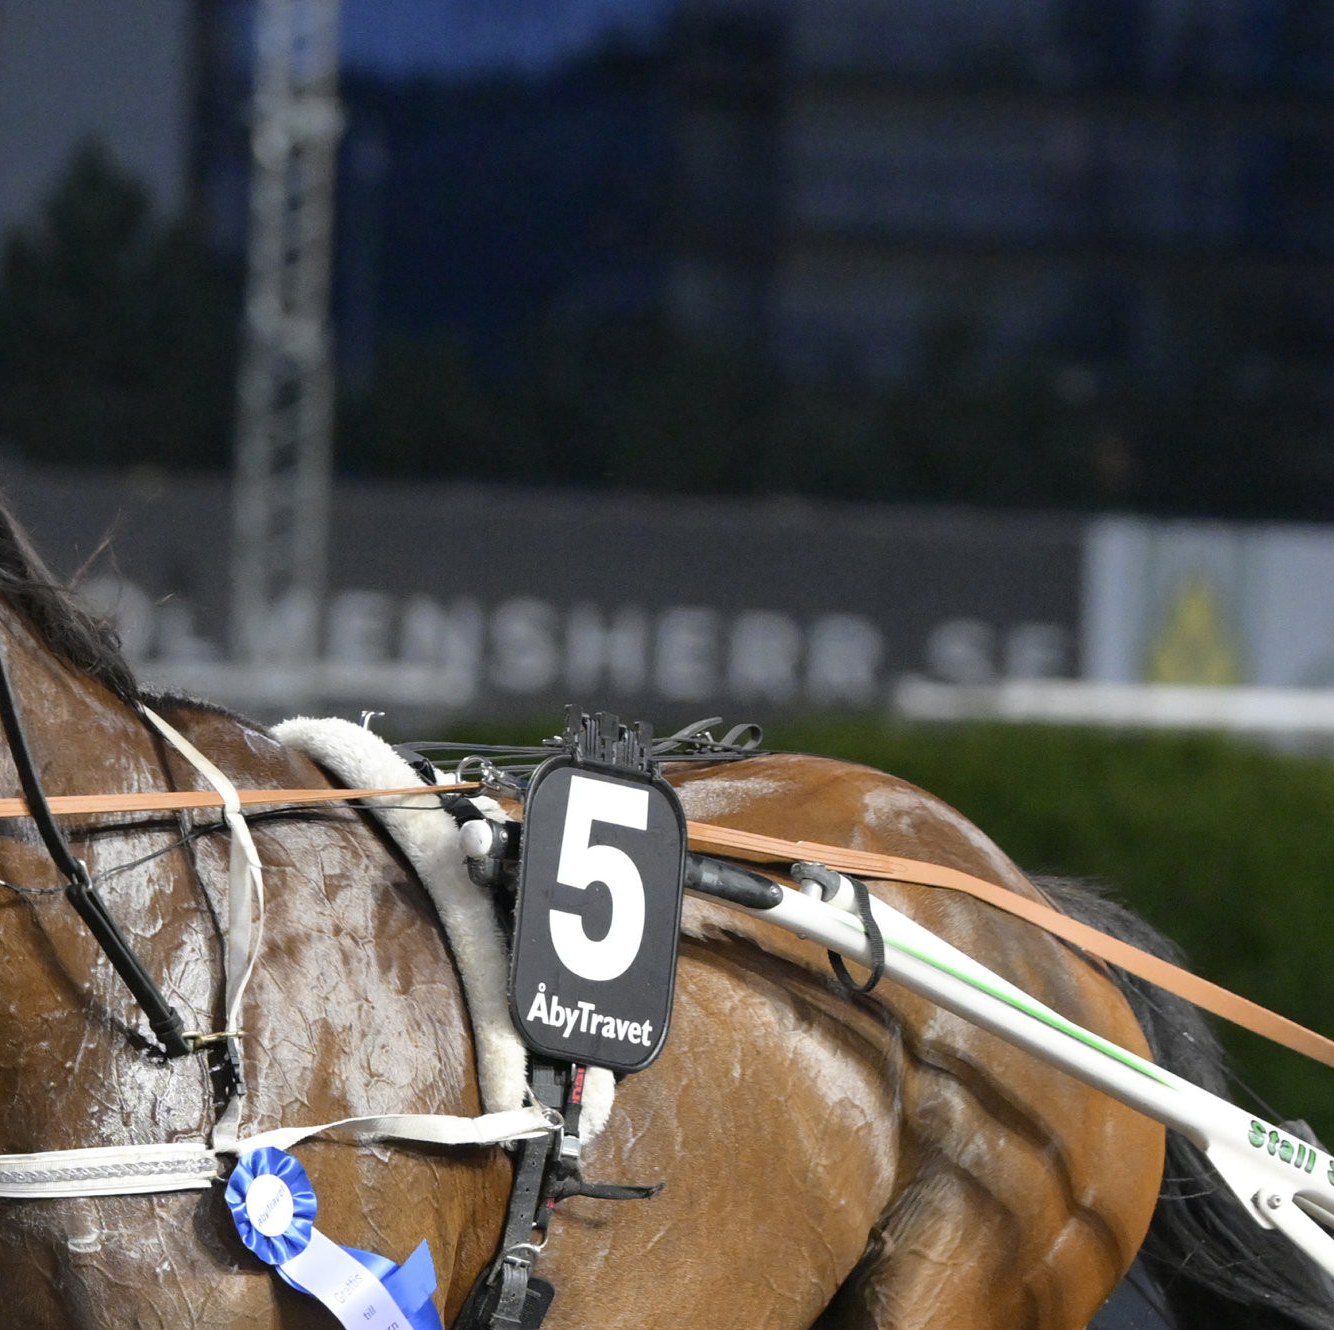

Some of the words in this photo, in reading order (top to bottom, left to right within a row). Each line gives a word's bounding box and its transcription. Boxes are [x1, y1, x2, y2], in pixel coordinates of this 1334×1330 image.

[549, 775, 649, 981] 5
[526, 982, 653, 1047] ÅbyTravet
[1248, 1119, 1317, 1174] Stall
[363, 1304, 377, 1321] till
